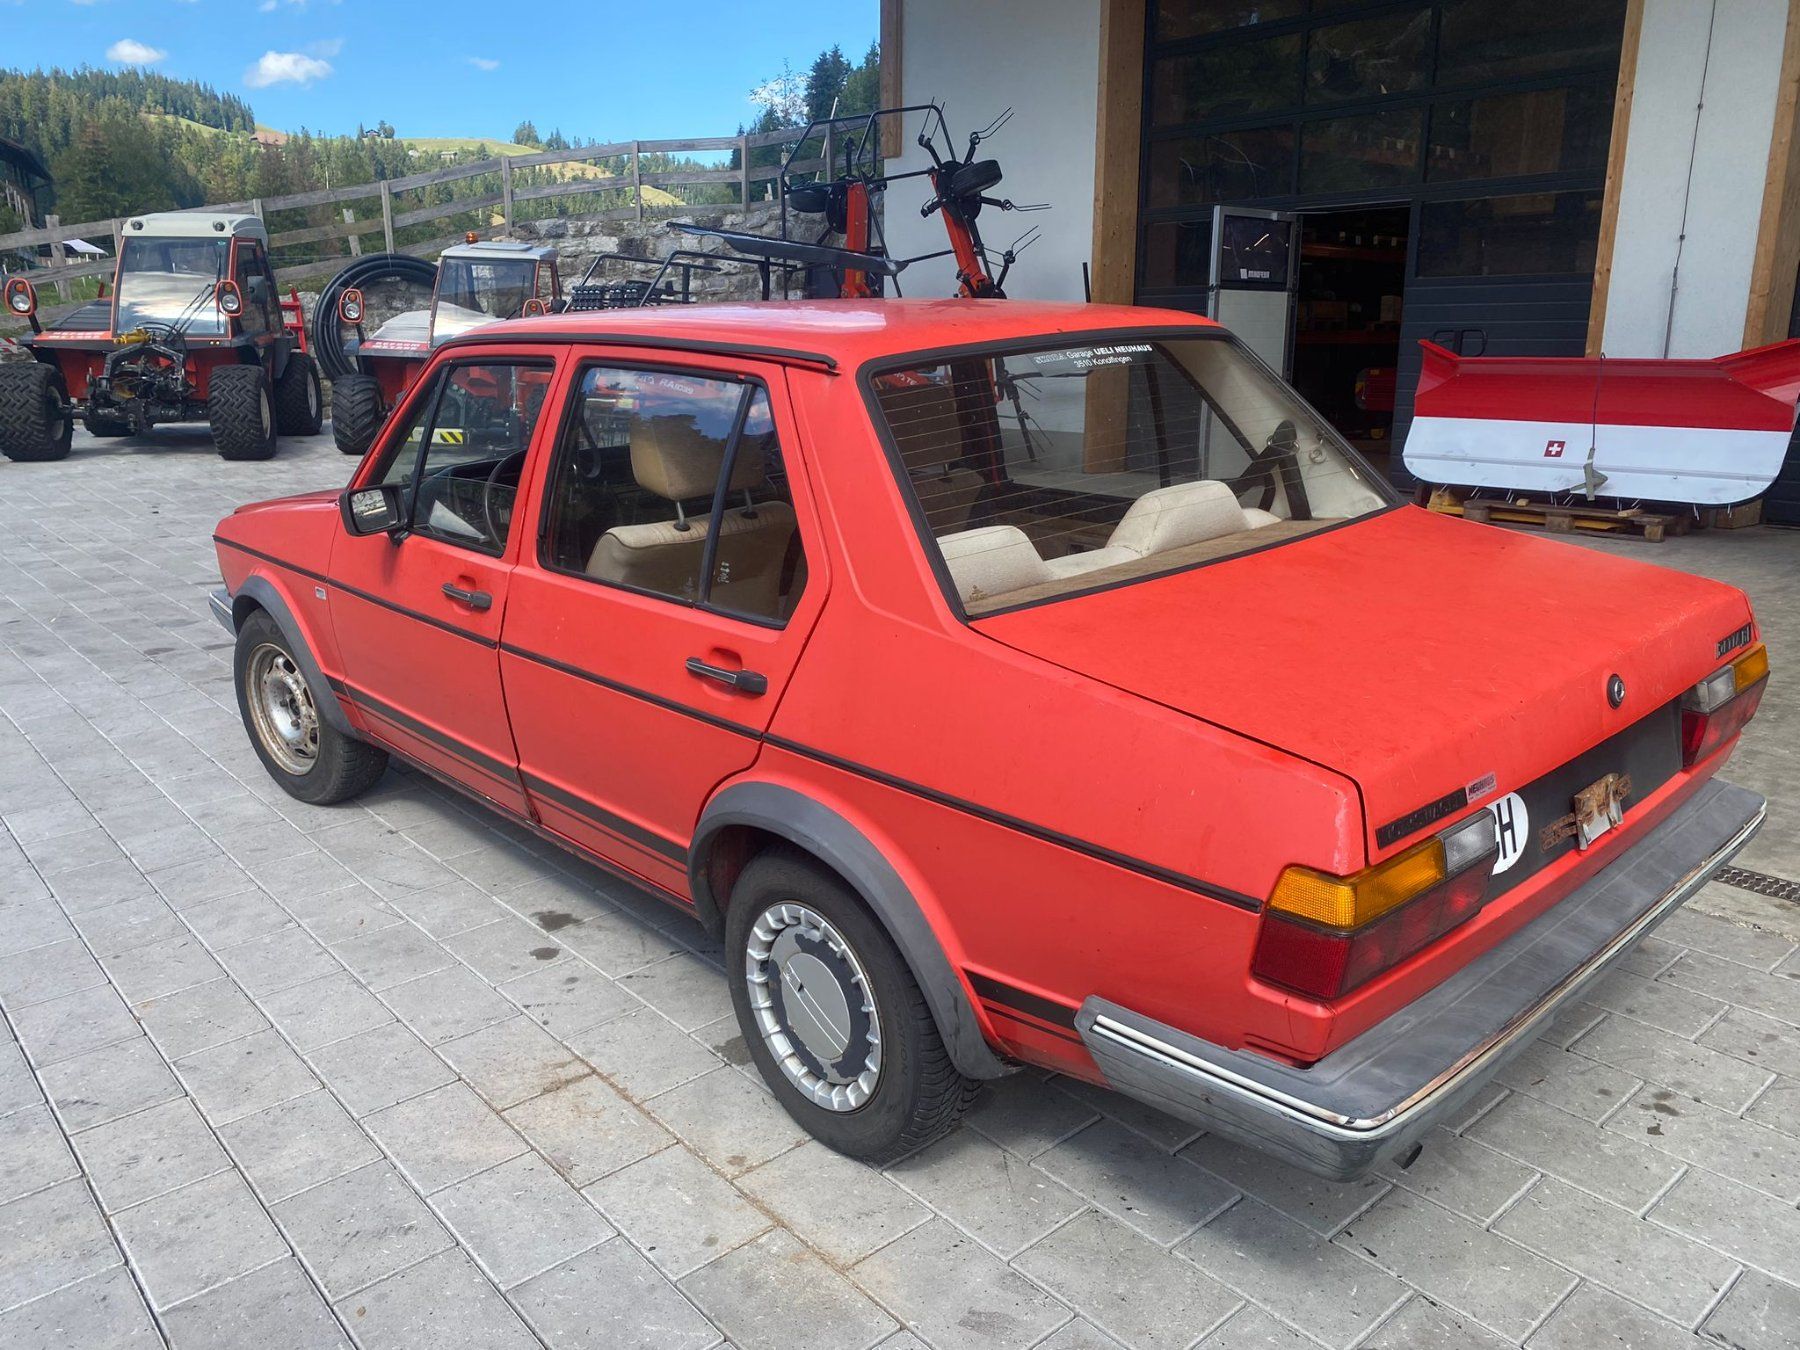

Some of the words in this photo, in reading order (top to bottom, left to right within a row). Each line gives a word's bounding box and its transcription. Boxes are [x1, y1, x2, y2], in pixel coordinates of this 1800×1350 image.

[1066, 350, 1094, 360] Garage
[1093, 346, 1114, 356] UELI
[1114, 344, 1153, 354] NEUHAUS
[1073, 359, 1093, 368] 3510
[1092, 355, 1133, 366] Konolfingen
